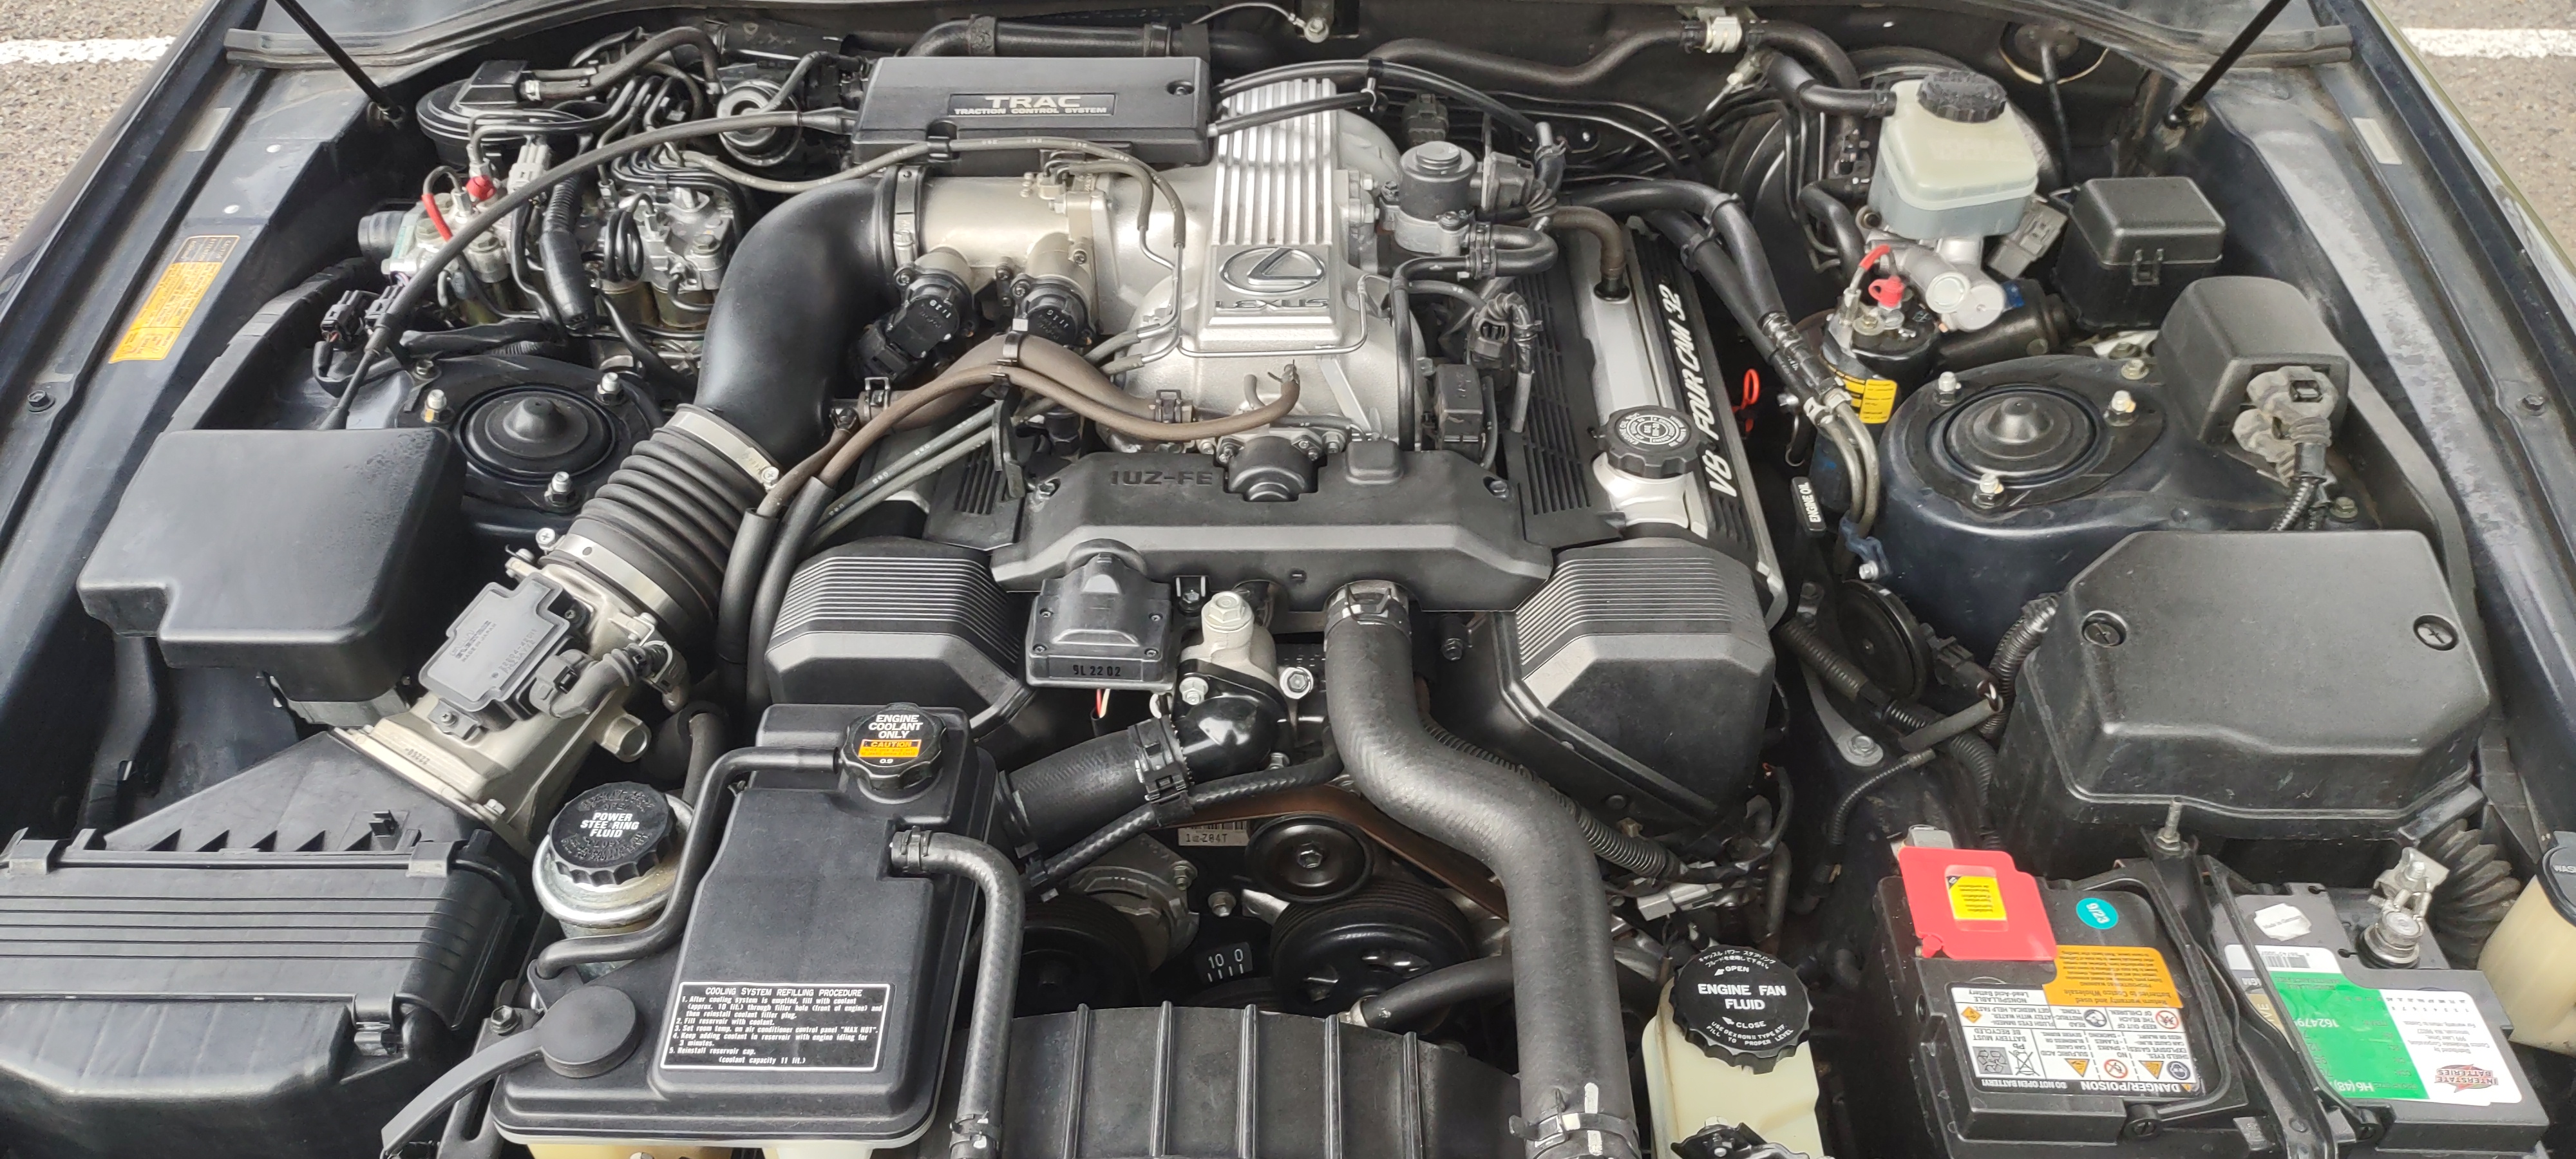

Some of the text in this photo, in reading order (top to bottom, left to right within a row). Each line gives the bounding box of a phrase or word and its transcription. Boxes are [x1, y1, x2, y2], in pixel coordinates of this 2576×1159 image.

[985, 96, 1082, 108] TRAC
[1215, 299, 1329, 309] LEXUS
[1659, 284, 1737, 497] V8 FOUR CAM 32
[1620, 428, 1640, 445] ENGINE
[1798, 482, 1821, 522] ENGINE OIL
[1090, 666, 1121, 677] 22 02
[592, 813, 633, 821] POWER
[589, 829, 623, 838] FLUID
[2086, 903, 2110, 923] 9/23
[1208, 948, 1244, 969] 10 0
[1698, 983, 1787, 996] ENGINE FAN
[1725, 999, 1765, 1010] FLUID
[1711, 1021, 1723, 1032] USE
[1706, 1025, 1721, 1037] FILL
[1774, 1030, 1794, 1042] LEVEL
[2080, 1081, 2181, 1092] DANGER/POISON
[2334, 1079, 2374, 1092] H6 (48)
